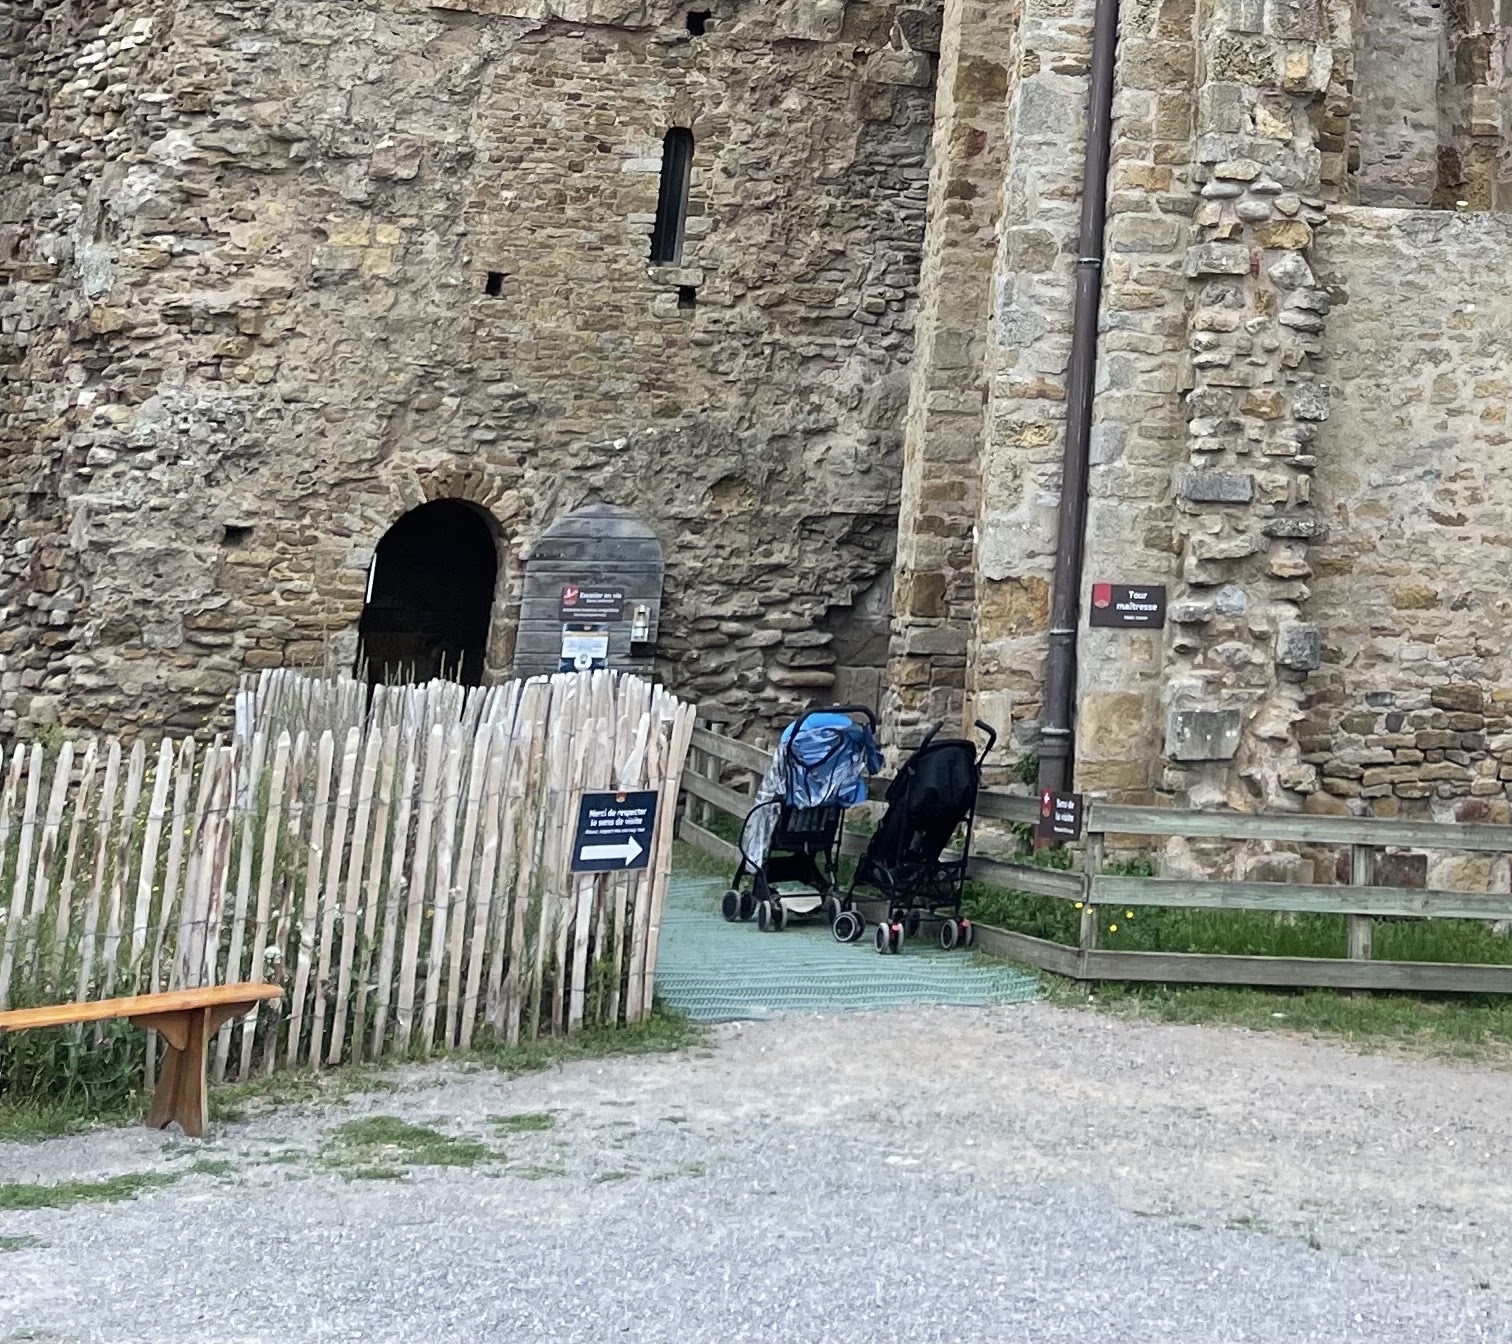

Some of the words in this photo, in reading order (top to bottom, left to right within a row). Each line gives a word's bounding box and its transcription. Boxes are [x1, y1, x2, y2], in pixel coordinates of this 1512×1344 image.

[1128, 590, 1148, 599] Tour
[1116, 601, 1158, 611] maîtresse
[588, 807, 607, 817] Merci
[607, 808, 616, 817] de
[617, 808, 647, 817] respecter
[615, 817, 624, 826] de
[624, 816, 643, 825] visite
